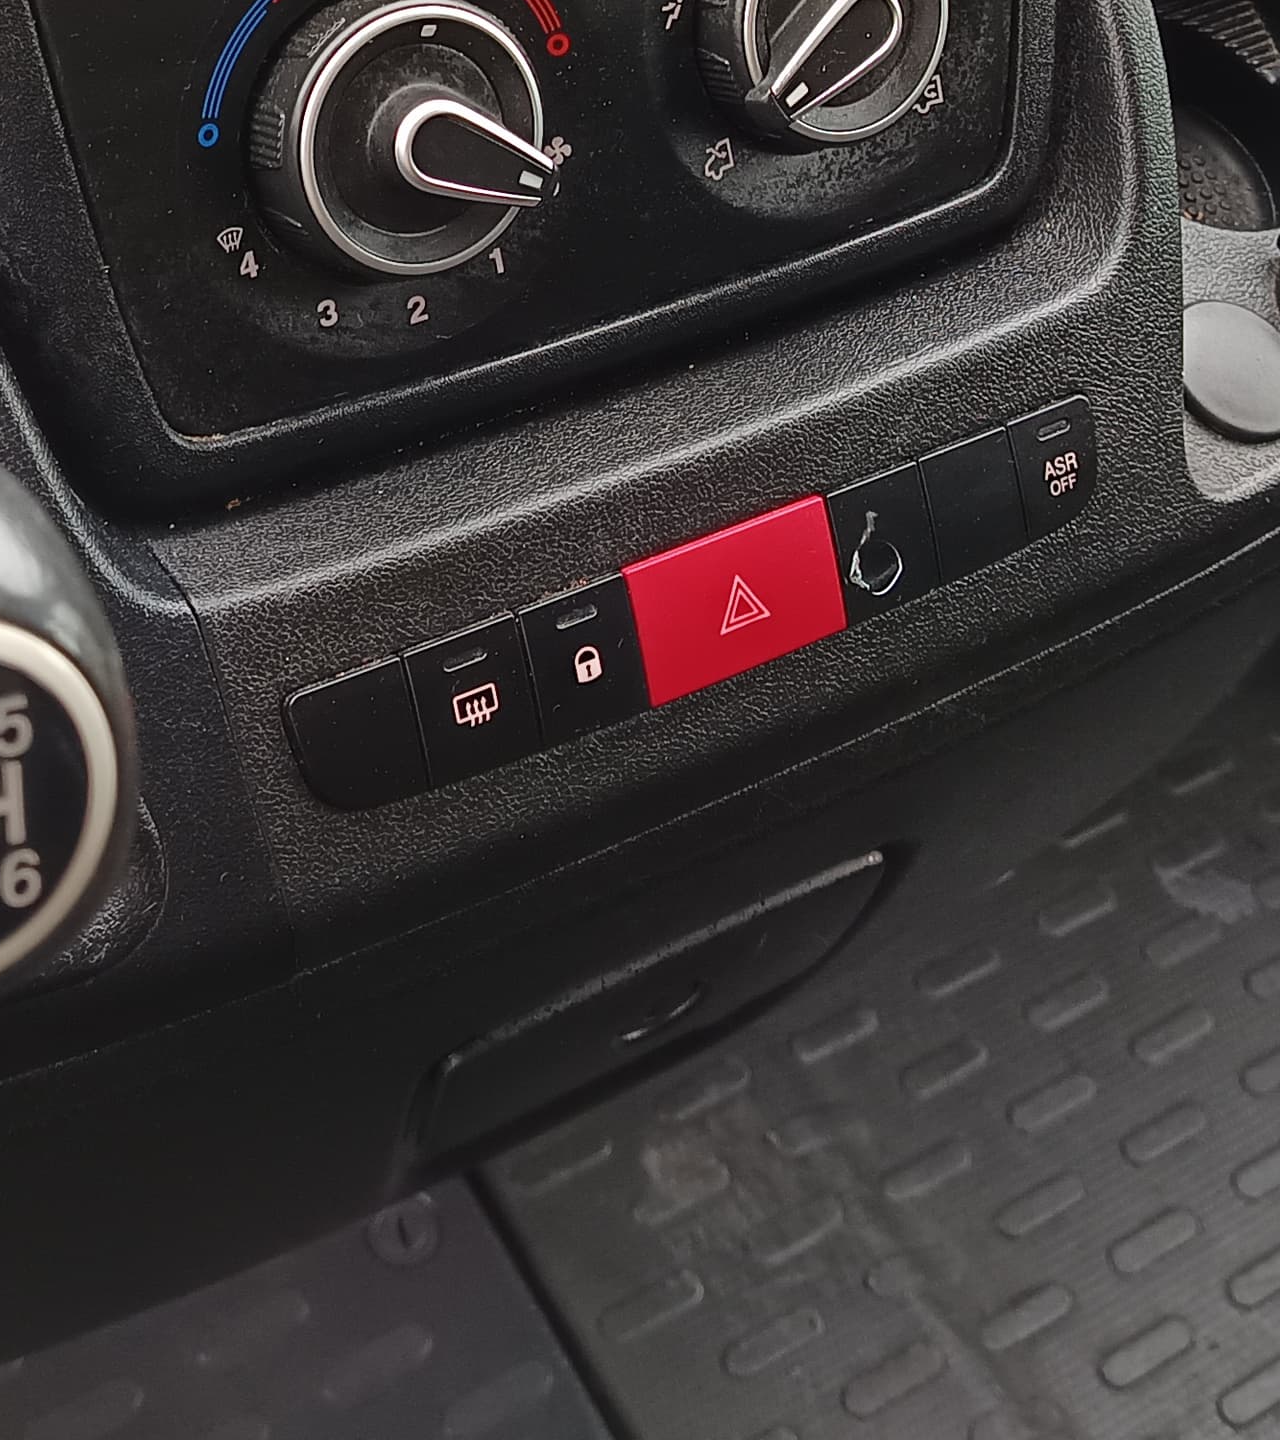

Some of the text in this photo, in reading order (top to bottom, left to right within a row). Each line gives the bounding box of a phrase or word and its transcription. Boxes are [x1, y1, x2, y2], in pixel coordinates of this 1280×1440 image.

[239, 251, 259, 278] 4
[488, 247, 505, 274] 1
[317, 300, 339, 327] 3
[407, 295, 429, 324] 2
[1043, 451, 1079, 481] ASR
[1048, 472, 1078, 497] OFF
